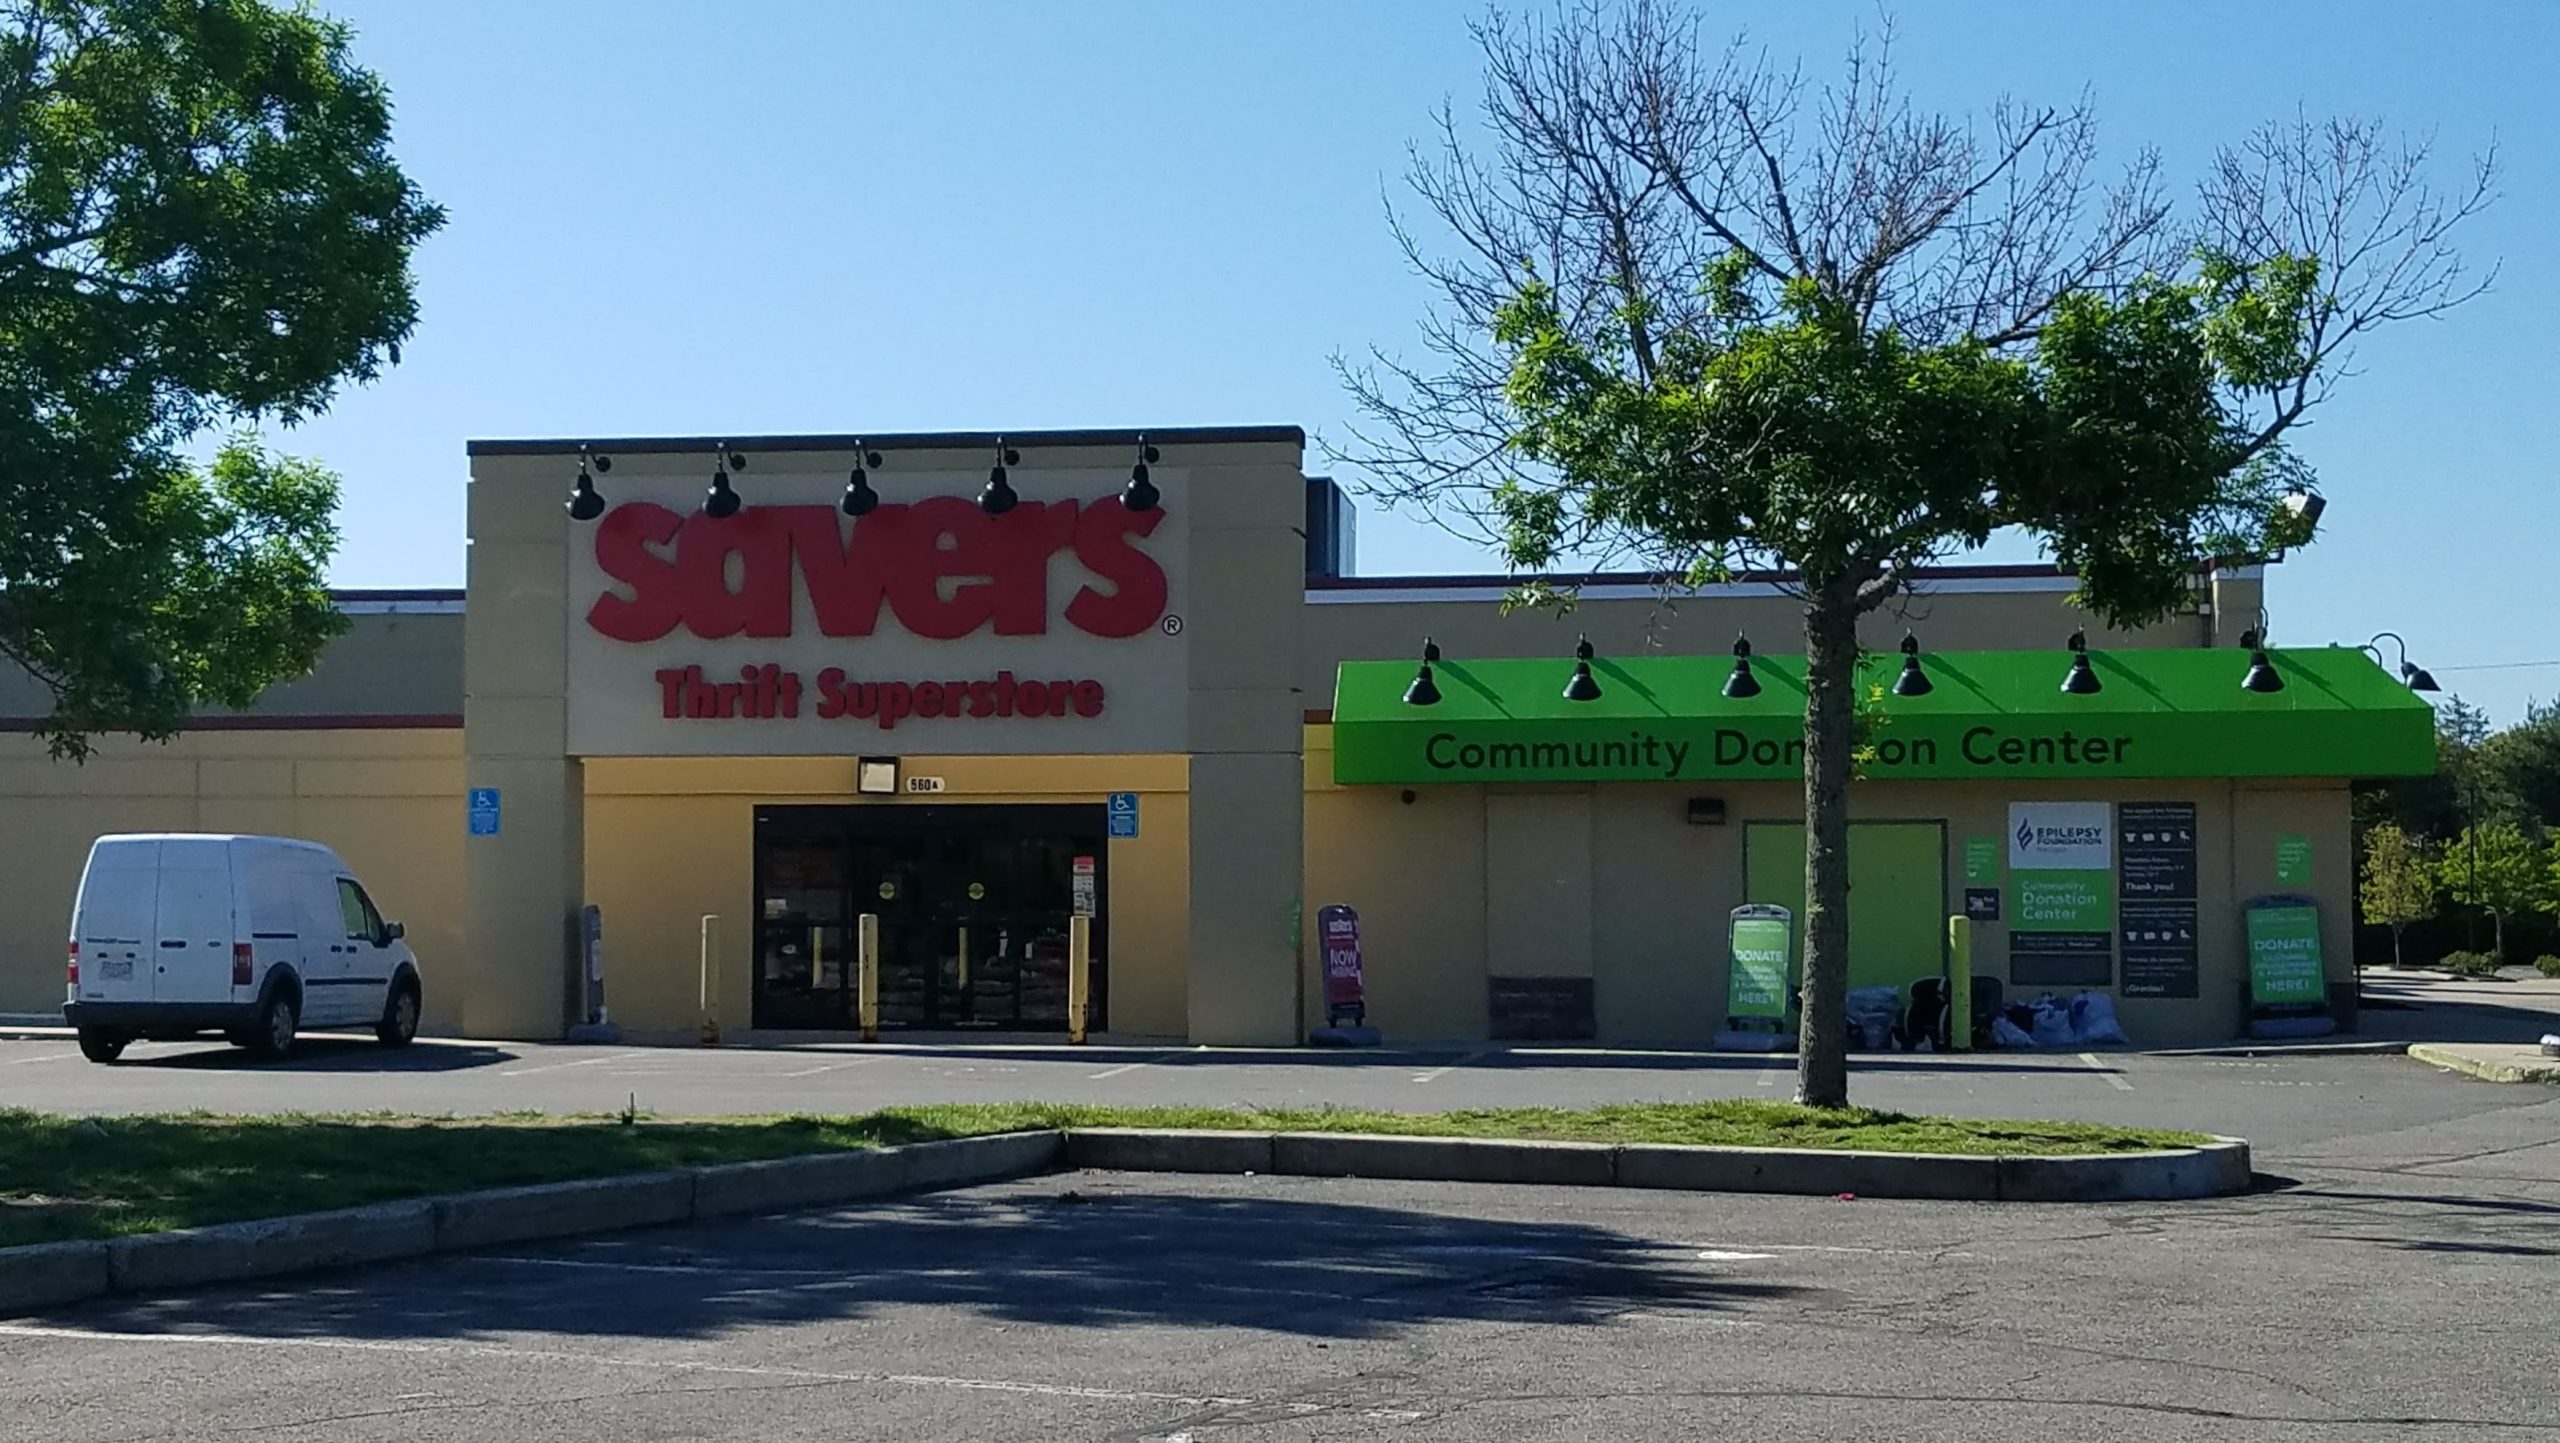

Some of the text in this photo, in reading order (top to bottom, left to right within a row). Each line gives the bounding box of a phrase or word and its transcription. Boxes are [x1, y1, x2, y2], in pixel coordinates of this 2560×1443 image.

[655, 664, 1104, 729] Thrift Superstore
[1425, 725, 2132, 778] Community Donon Center
[2036, 827, 2102, 838] EPILEPSY
[2036, 837, 2102, 845] FOUNDATION
[2021, 881, 2086, 892] Community
[2126, 883, 2175, 892] Thank you!
[2022, 892, 2097, 905] Donation
[2022, 907, 2077, 920] Center
[2254, 938, 2315, 950] DONATE
[1330, 948, 1358, 966] NOW
[1735, 950, 1784, 962] DONATE
[2265, 979, 2309, 992] HERE!
[1739, 992, 1774, 1004] HERE!
